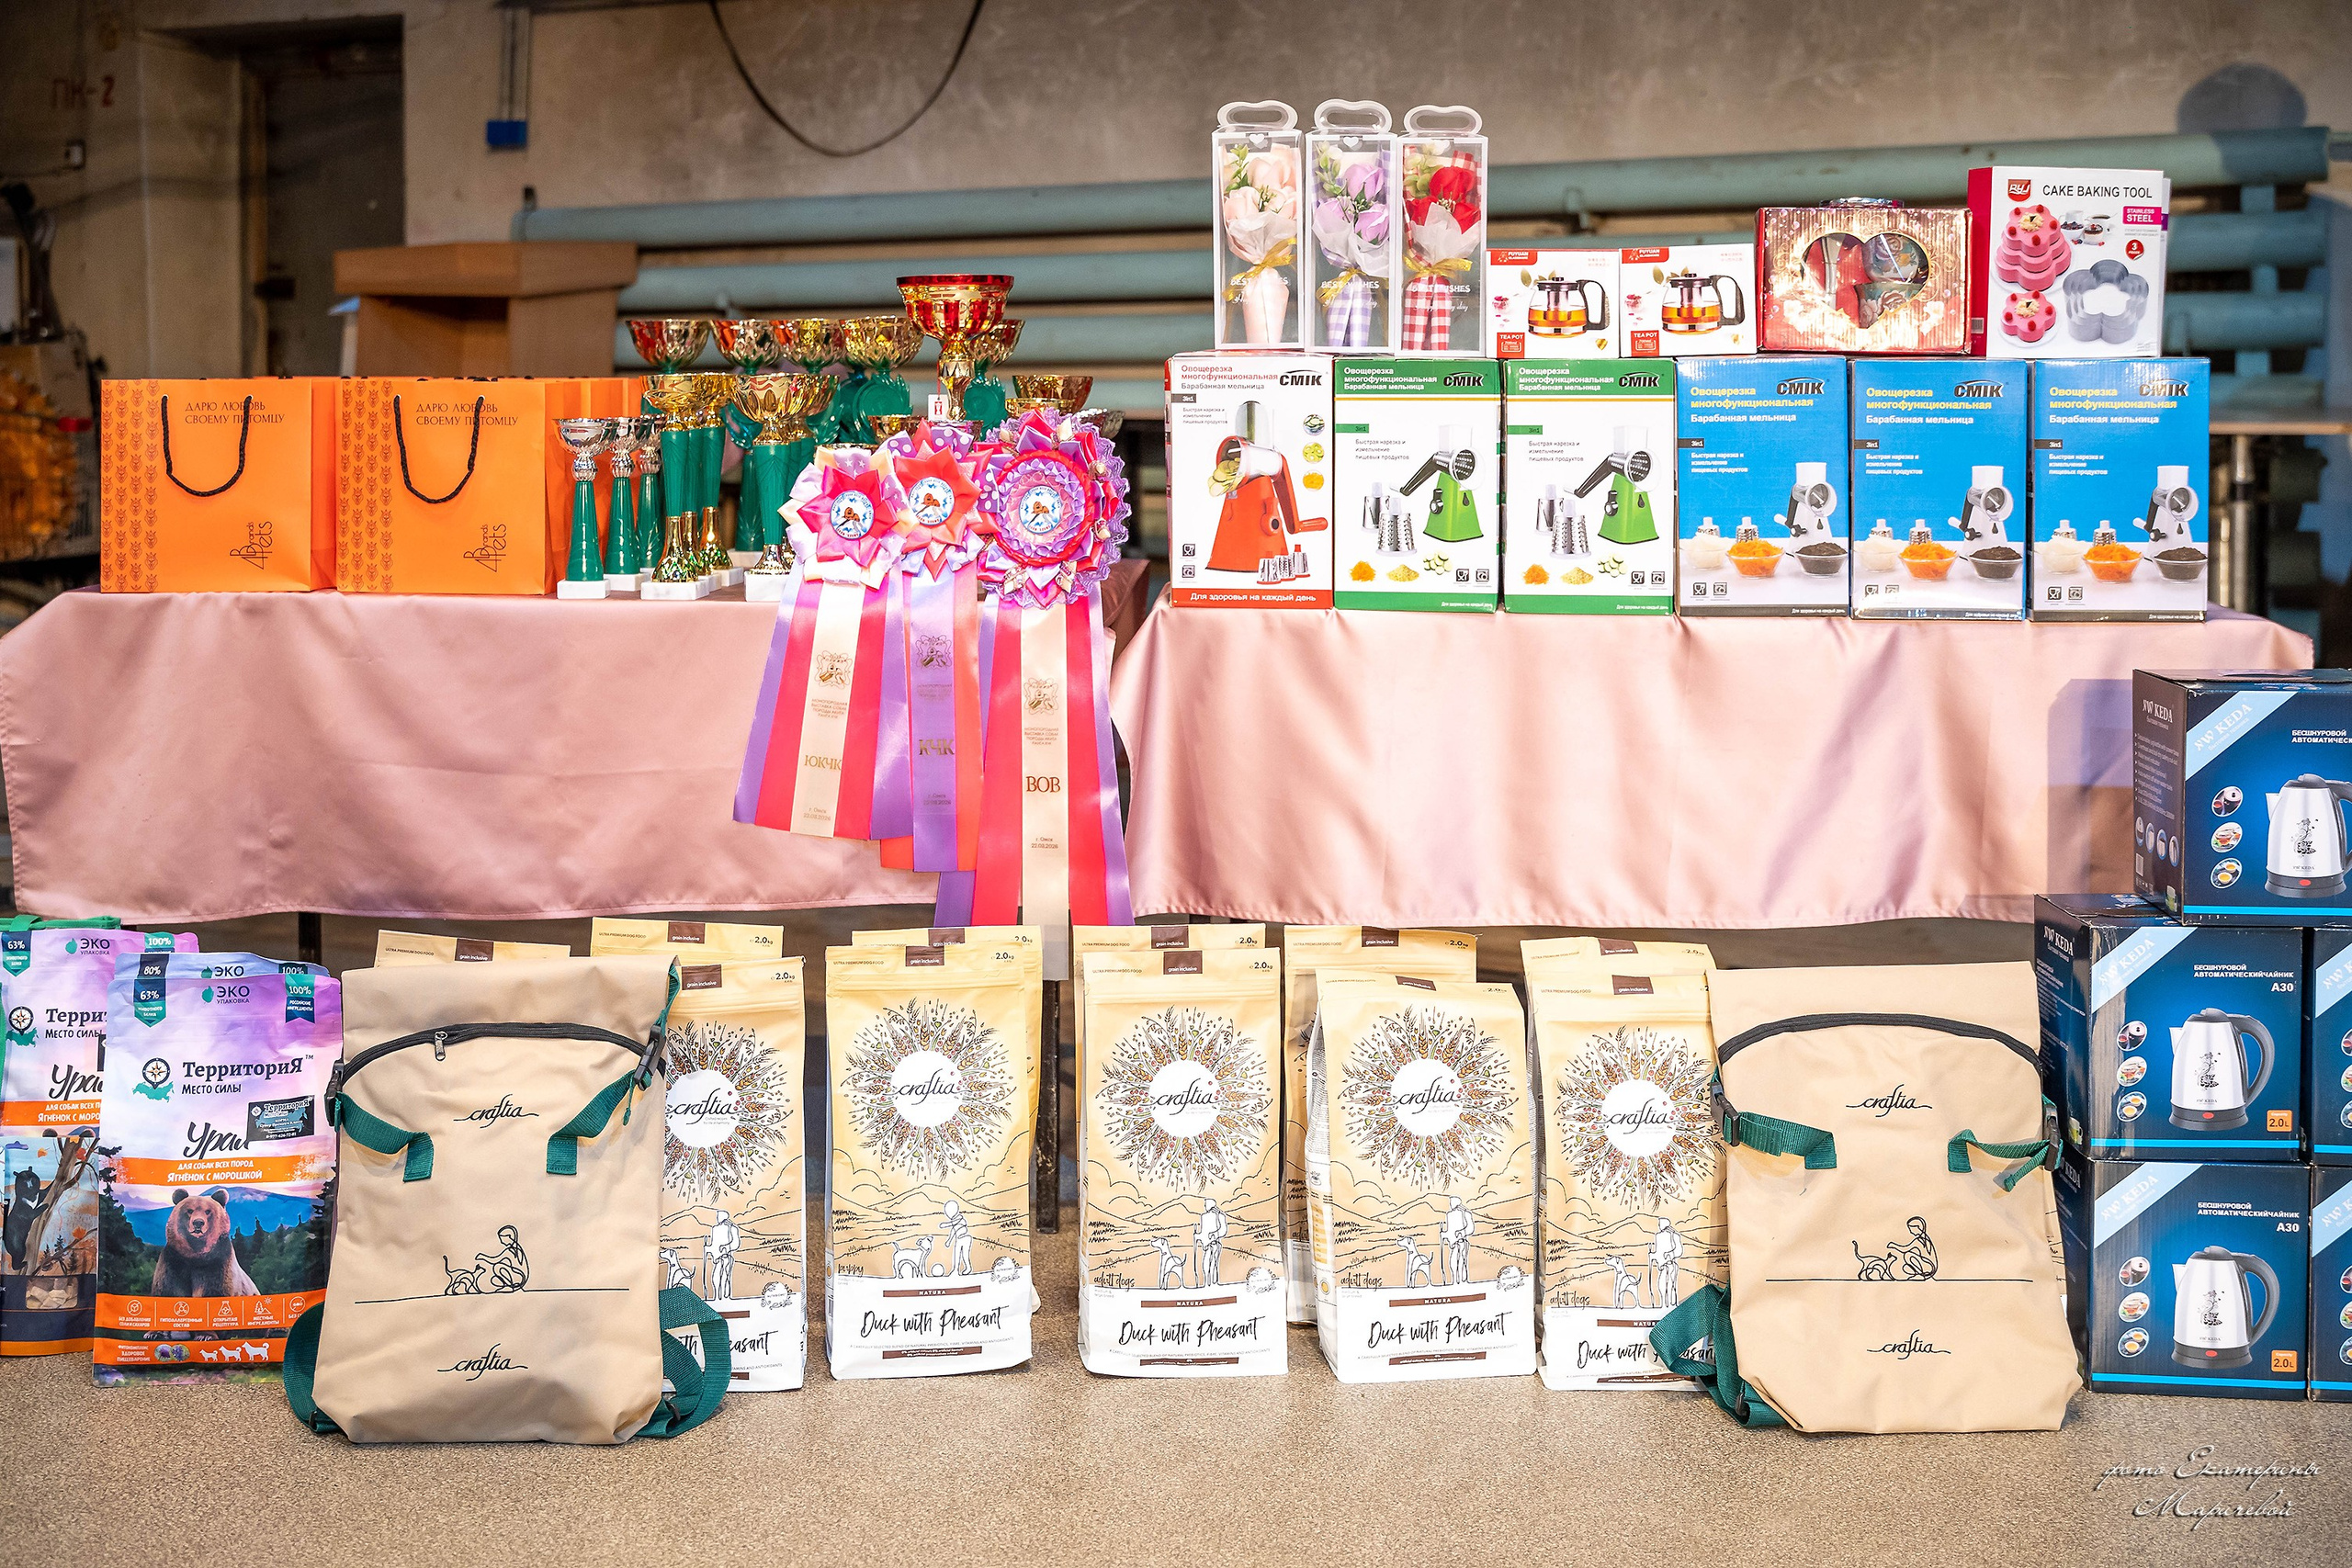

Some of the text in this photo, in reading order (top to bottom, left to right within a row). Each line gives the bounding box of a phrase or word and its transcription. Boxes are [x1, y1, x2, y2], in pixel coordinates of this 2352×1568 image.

[2043, 186, 2153, 198] CAKE BAKING TOOL
[2132, 243, 2137, 251] 3
[1182, 373, 1278, 381] многофункциональная
[1519, 367, 1570, 376] Овощерезка
[1690, 387, 1757, 397] Овощерезка
[1866, 388, 1933, 398] Овощерезка
[2050, 387, 2118, 398] Овощерезка
[185, 402, 218, 412] ДАРЮ
[416, 403, 448, 413] ДАРЮ
[1690, 399, 1814, 410] многофункциональная
[1866, 400, 1992, 412] многофункциональная
[2050, 400, 2177, 411] многофункциональная
[185, 414, 230, 424] СВОЕМУ
[416, 416, 461, 426] СВОЕМУ
[1690, 414, 1747, 423] Барабанная
[1866, 415, 1974, 424] Барабанная мельница
[2049, 415, 2159, 424] Барабанная мельница
[2154, 704, 2173, 723] KEDA
[2214, 704, 2253, 734] KEDA
[919, 739, 956, 756] КЧК
[804, 755, 842, 771] ЮКЧК
[7, 941, 26, 950] 63%
[80, 938, 111, 949] ЭКО
[148, 937, 172, 946] 100%
[2055, 932, 2074, 956] KEDA
[2119, 939, 2155, 969] KEDA
[144, 966, 161, 976] 80%
[214, 966, 244, 977] ЭКО
[282, 966, 305, 975] 100%
[217, 986, 251, 998] ЭКО
[288, 987, 312, 996] 100%
[2271, 983, 2294, 992] A30
[140, 990, 160, 1001] 63%
[892, 1068, 964, 1106] craftia
[1149, 1077, 1221, 1116] craftia
[1391, 1076, 1463, 1114] craftia
[1849, 1084, 1929, 1117] craftia
[46, 1103, 58, 1111] ДЛЯ
[457, 1093, 536, 1128] craftia
[669, 1088, 739, 1125] craftia
[1601, 1098, 1674, 1134] craftia
[177, 1159, 254, 1170] ДЛЯ СОБАК ВСЕХ ПОРОД
[206, 1172, 212, 1181] С
[213, 1168, 263, 1181] МОРОШКОЙ
[2121, 1176, 2159, 1204] KEDA
[2198, 1201, 2252, 1210] БЕСШНУРОВОЙ
[2277, 1223, 2300, 1233] A30
[838, 1264, 865, 1278] puppy
[1116, 1273, 1136, 1292] dogs
[1363, 1274, 1383, 1292] dogs
[1571, 1292, 1590, 1310] dogs
[861, 1305, 1010, 1338] Duck with Pheasant
[1119, 1315, 1266, 1348] Duck with Pheasant
[1368, 1312, 1513, 1348] Duck with Pheasant
[1577, 1340, 1648, 1370] Duck with
